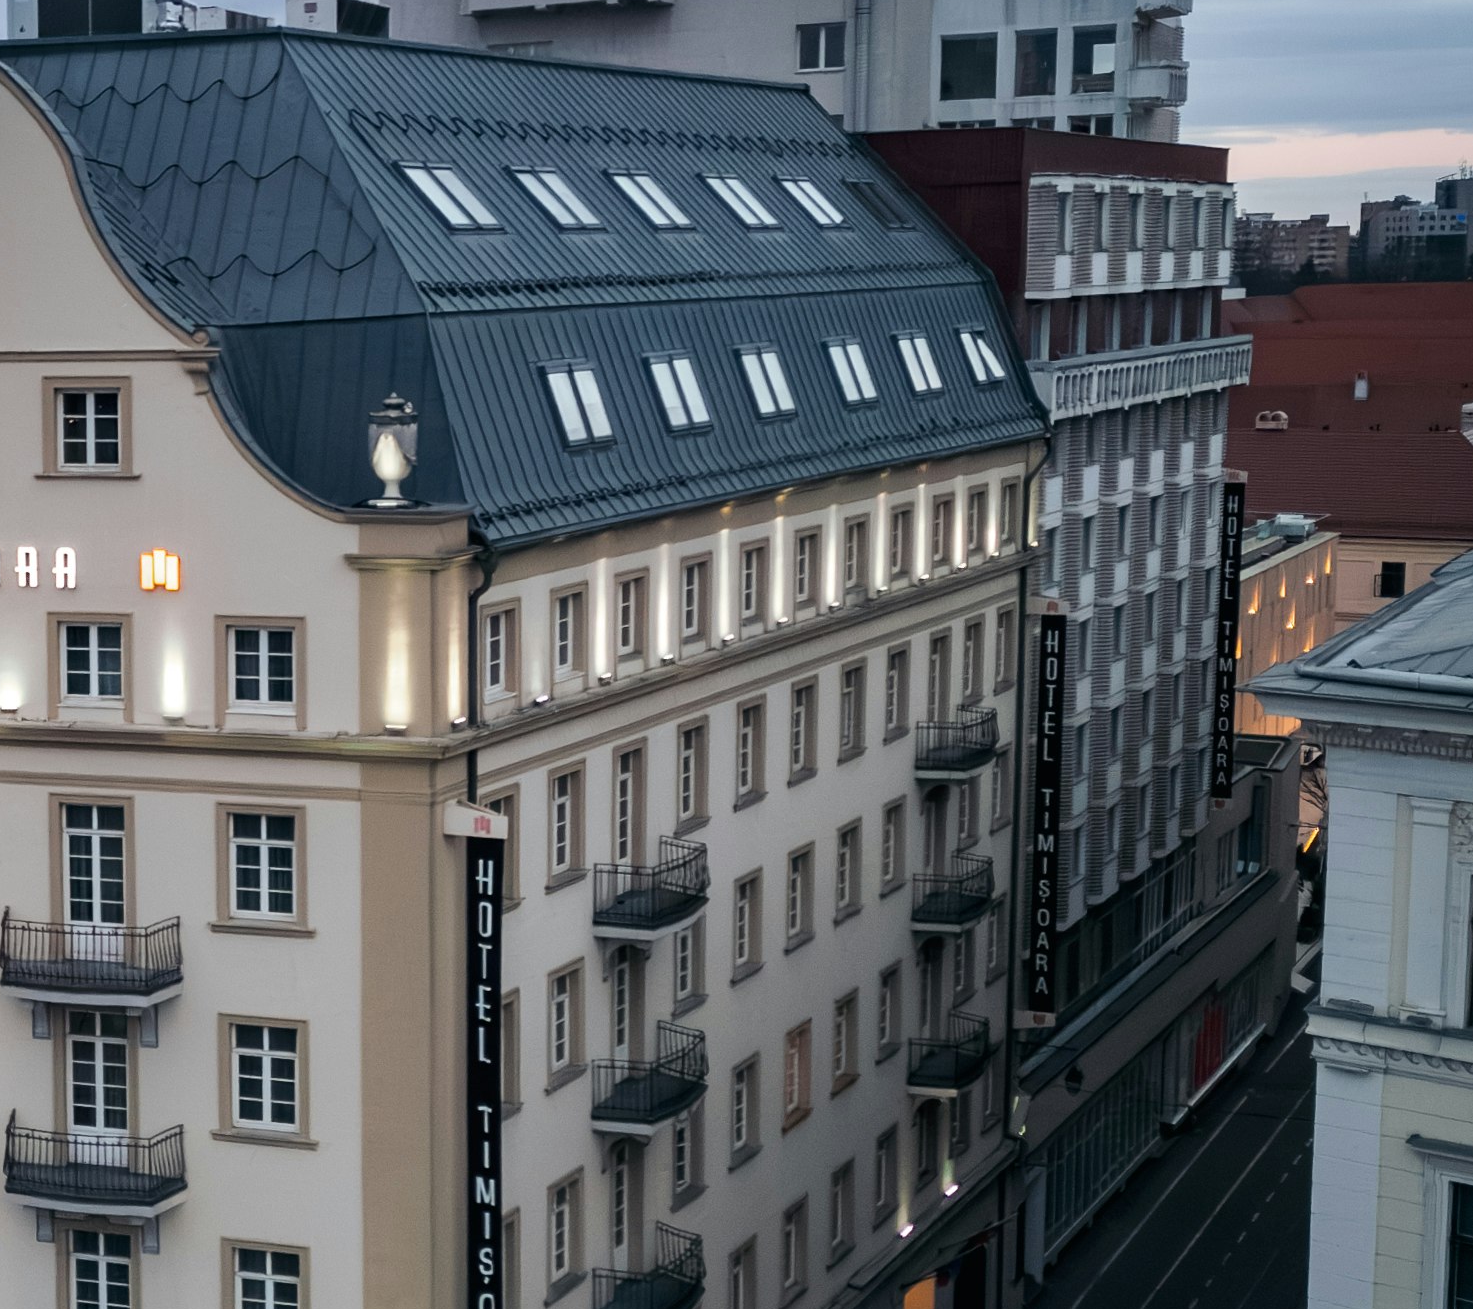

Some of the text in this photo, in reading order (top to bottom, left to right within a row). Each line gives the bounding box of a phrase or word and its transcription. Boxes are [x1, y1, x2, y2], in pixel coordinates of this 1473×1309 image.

[1224, 495, 1239, 600] HOTEL
[1035, 630, 1059, 996] HOTEL TIMIȘOARA
[473, 859, 494, 1063] HOTEL
